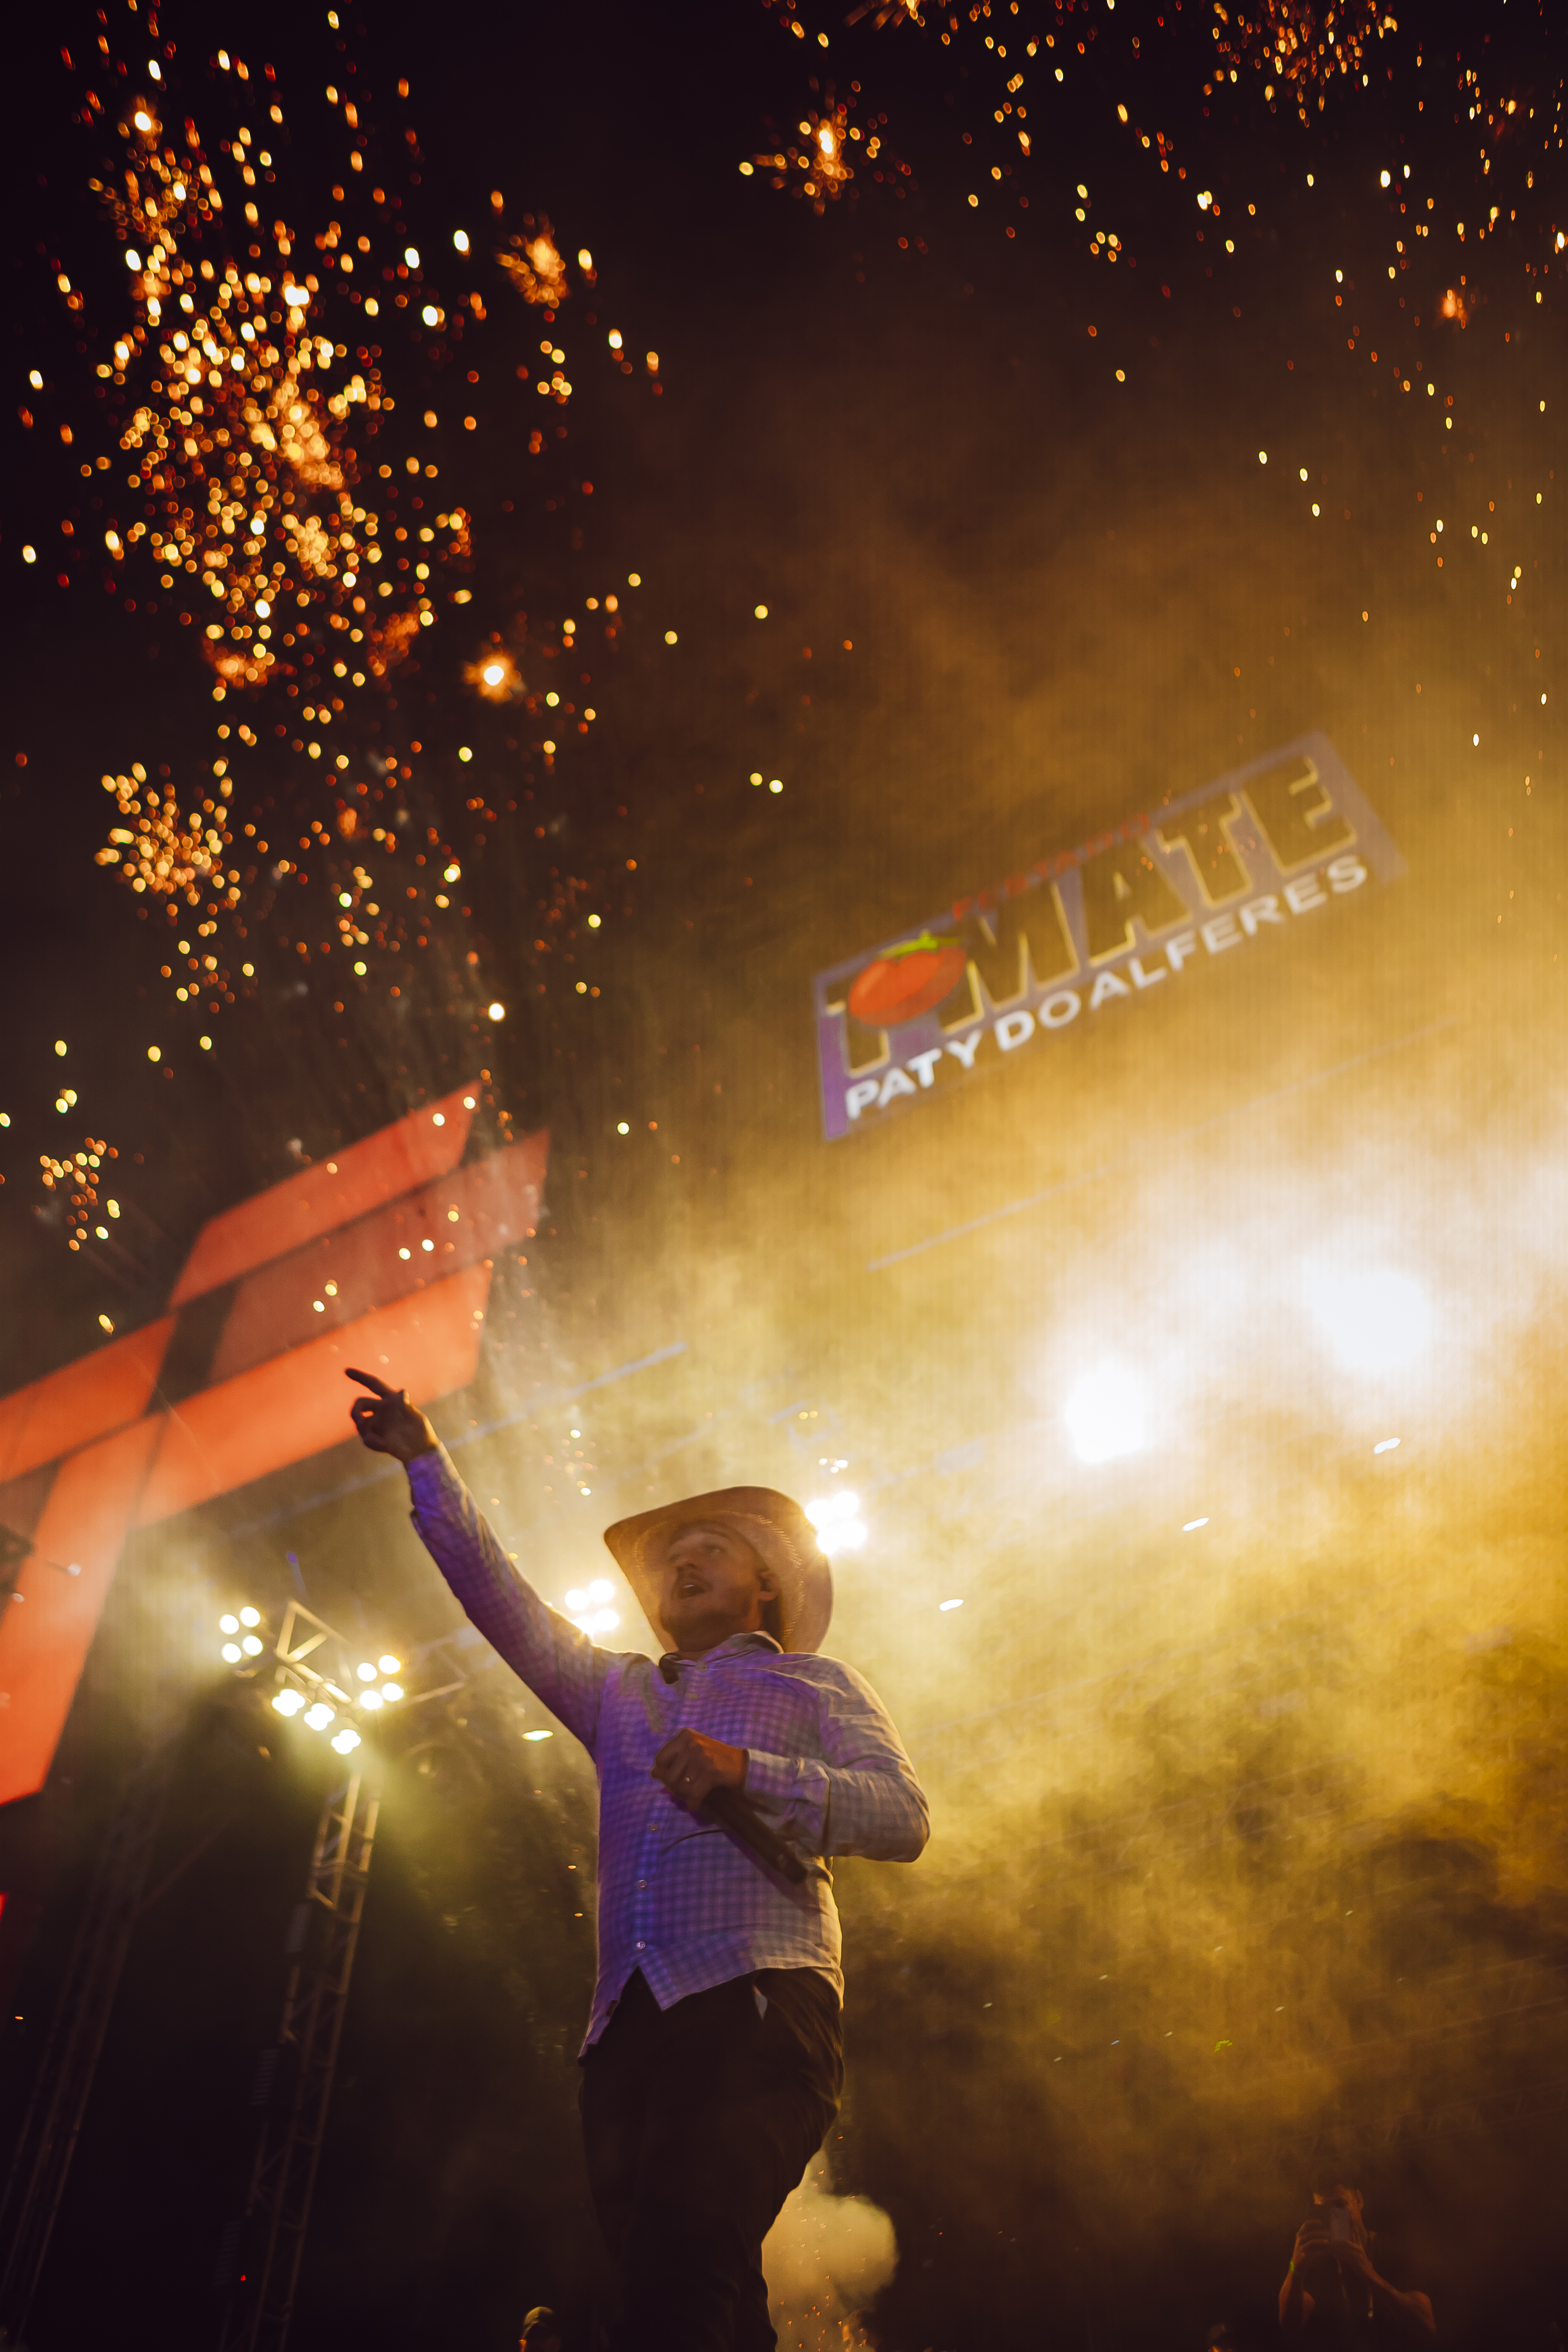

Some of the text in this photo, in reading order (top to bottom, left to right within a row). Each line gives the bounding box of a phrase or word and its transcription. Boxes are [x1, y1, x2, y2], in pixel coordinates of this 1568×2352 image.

[1085, 812, 1151, 857] DO
[845, 855, 1368, 1118] PATY DO ALFERES
